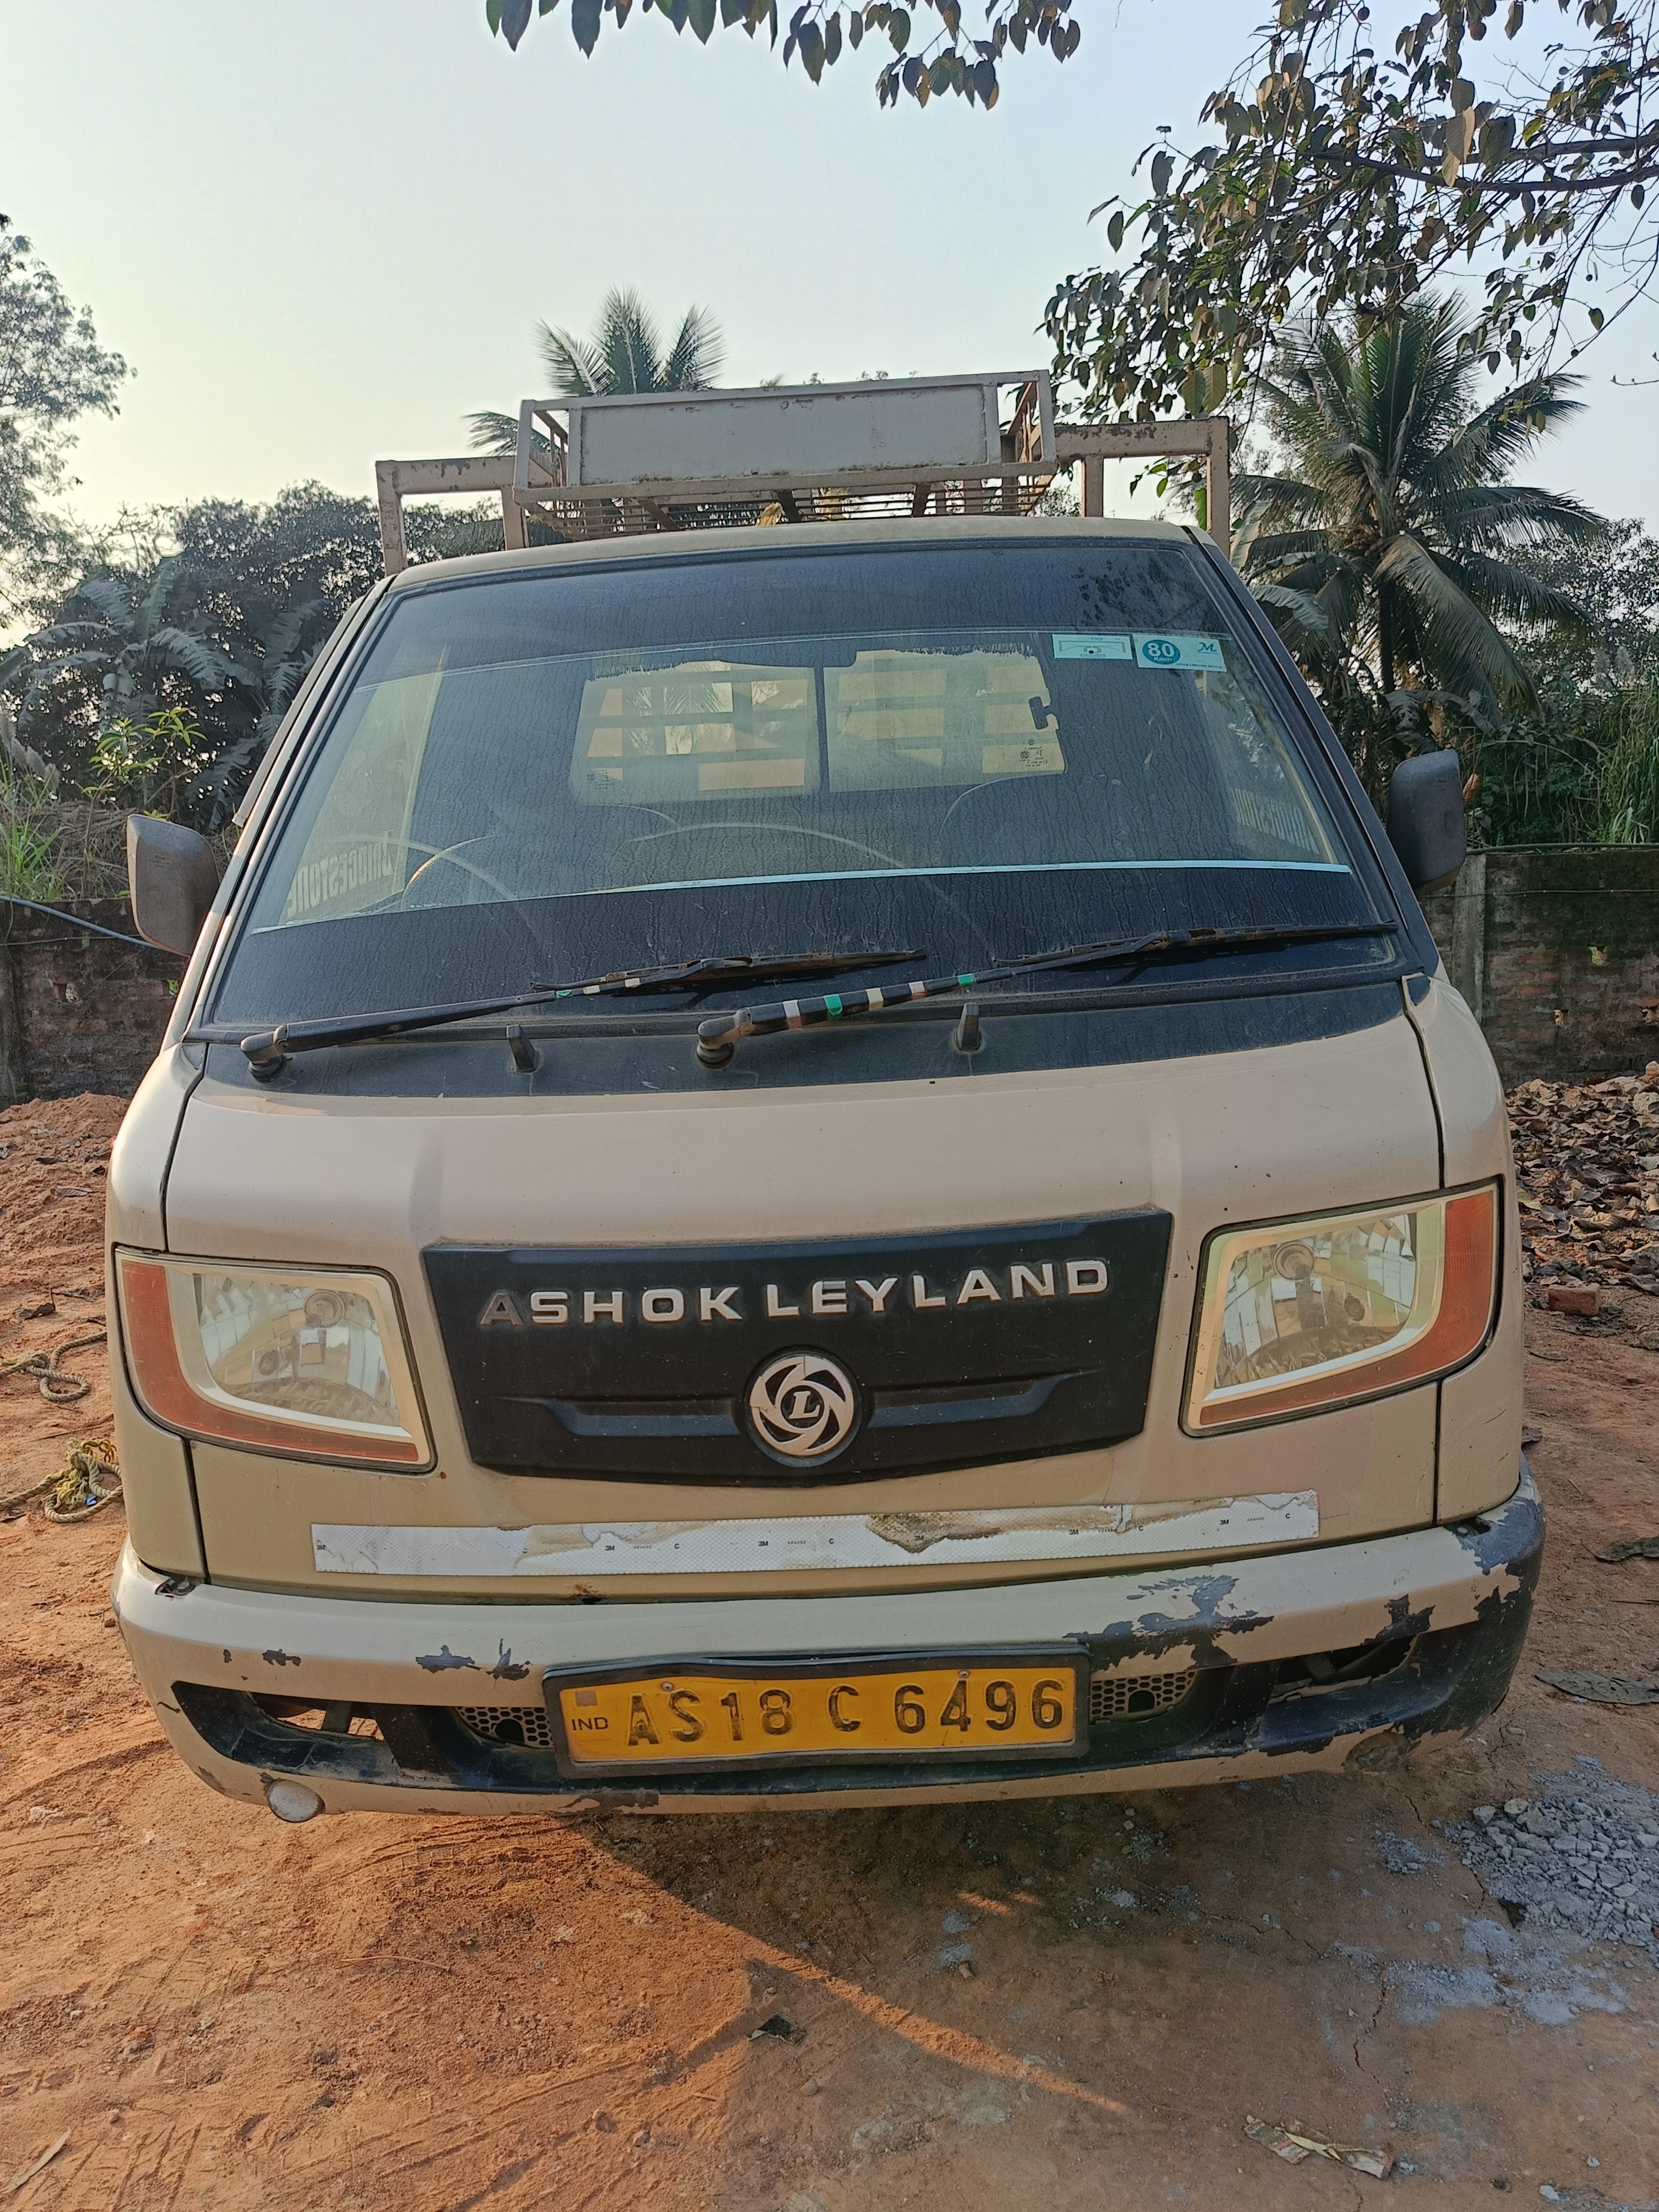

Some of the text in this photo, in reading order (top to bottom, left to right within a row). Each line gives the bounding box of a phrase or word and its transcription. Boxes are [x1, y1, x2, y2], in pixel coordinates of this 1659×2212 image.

[1147, 642, 1175, 658] 80
[478, 1259, 1110, 1327] ASHOK LEYLAND
[789, 1391, 821, 1420] L
[571, 1717, 609, 1731] IND
[628, 1679, 1063, 1746] AS18 C 6496
